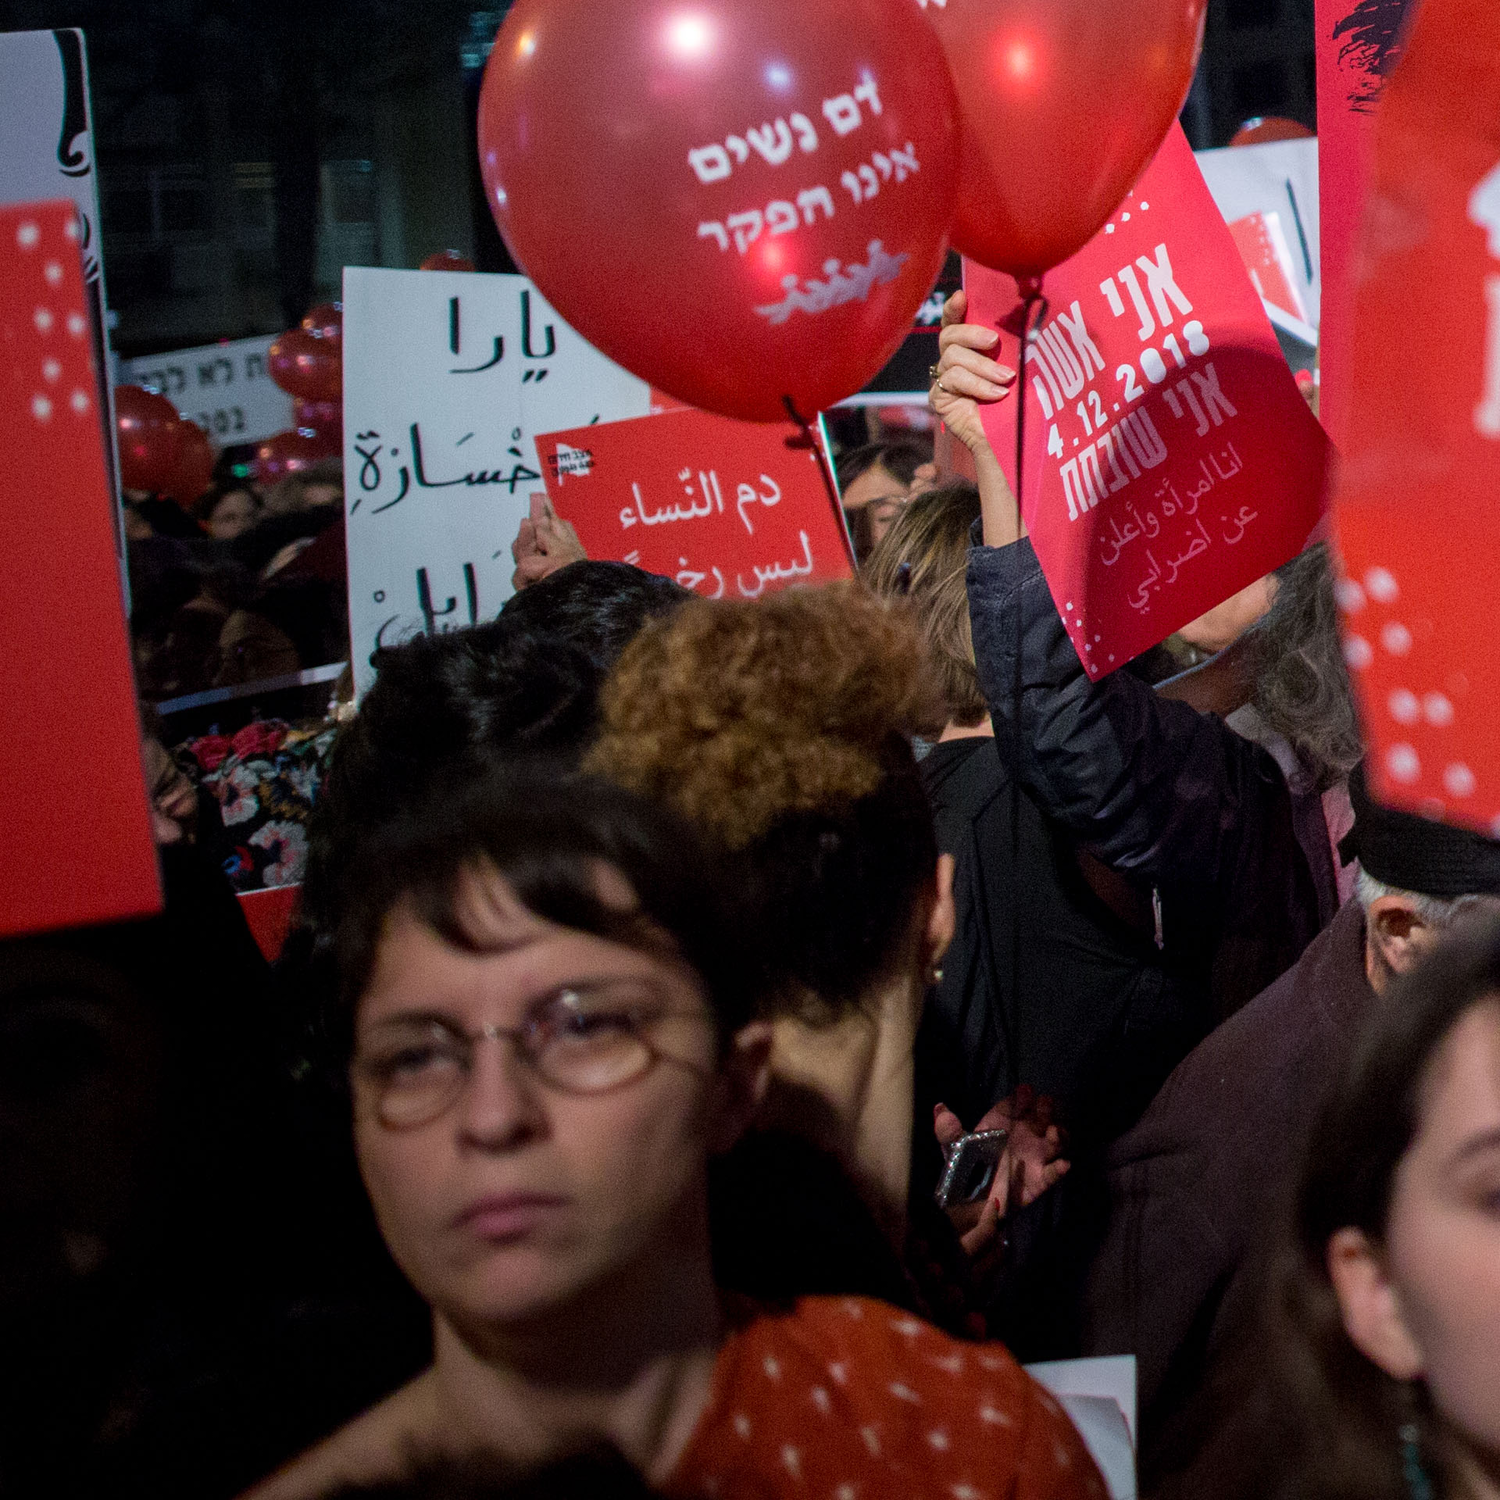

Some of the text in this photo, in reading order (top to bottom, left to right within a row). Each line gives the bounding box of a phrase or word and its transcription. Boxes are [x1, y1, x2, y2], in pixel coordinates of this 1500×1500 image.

[688, 77, 882, 184] דם נשים
[697, 142, 920, 255] אינו הפקר
[1025, 243, 1194, 420] אני אשה
[1047, 320, 1210, 460] 4.12.2018
[1059, 362, 1238, 522] אני שובתת
[736, 473, 781, 535] دم
[1221, 504, 1259, 544] عن
